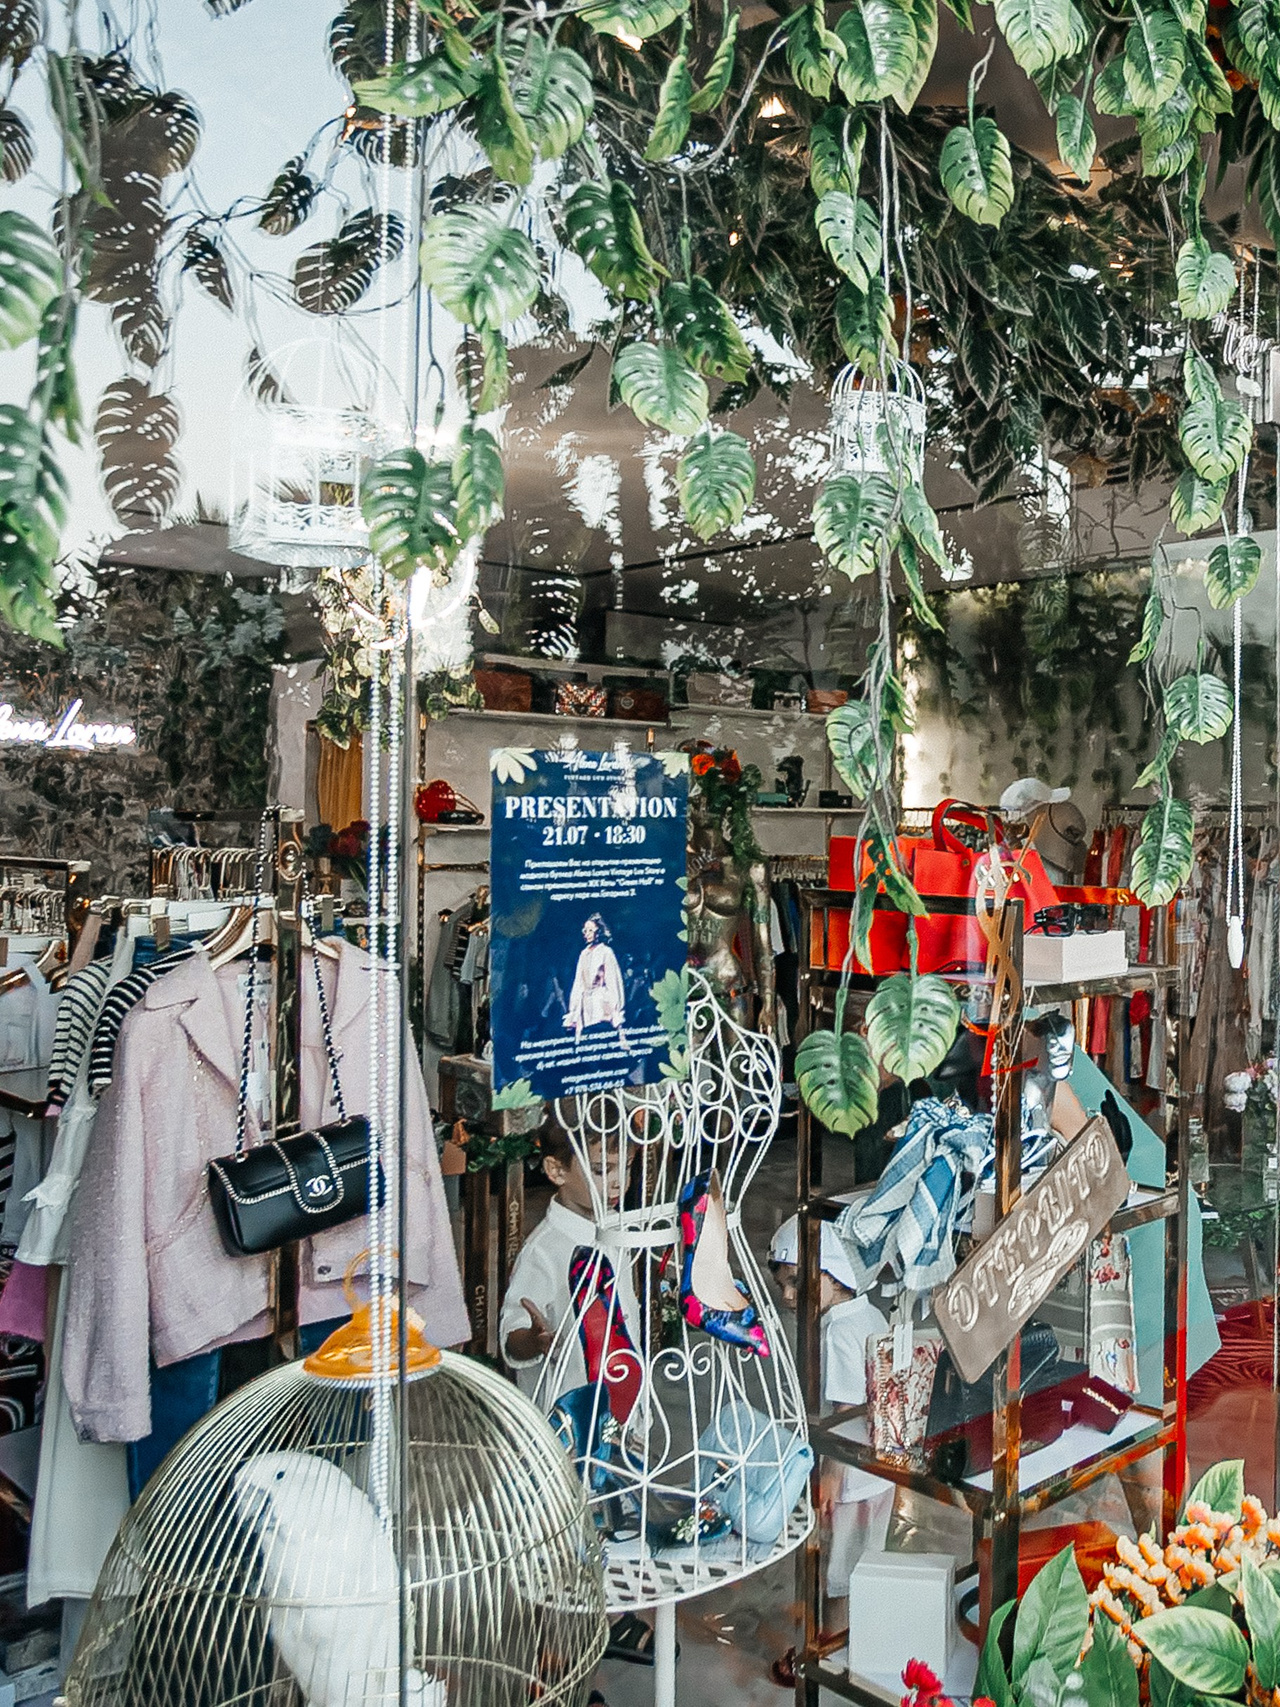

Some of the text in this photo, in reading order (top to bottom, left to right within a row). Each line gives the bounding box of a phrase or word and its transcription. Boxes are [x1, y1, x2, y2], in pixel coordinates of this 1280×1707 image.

[43, 697, 138, 751] Loran
[504, 795, 679, 819] PRESENTTION
[542, 824, 648, 846] 21.07 18:30
